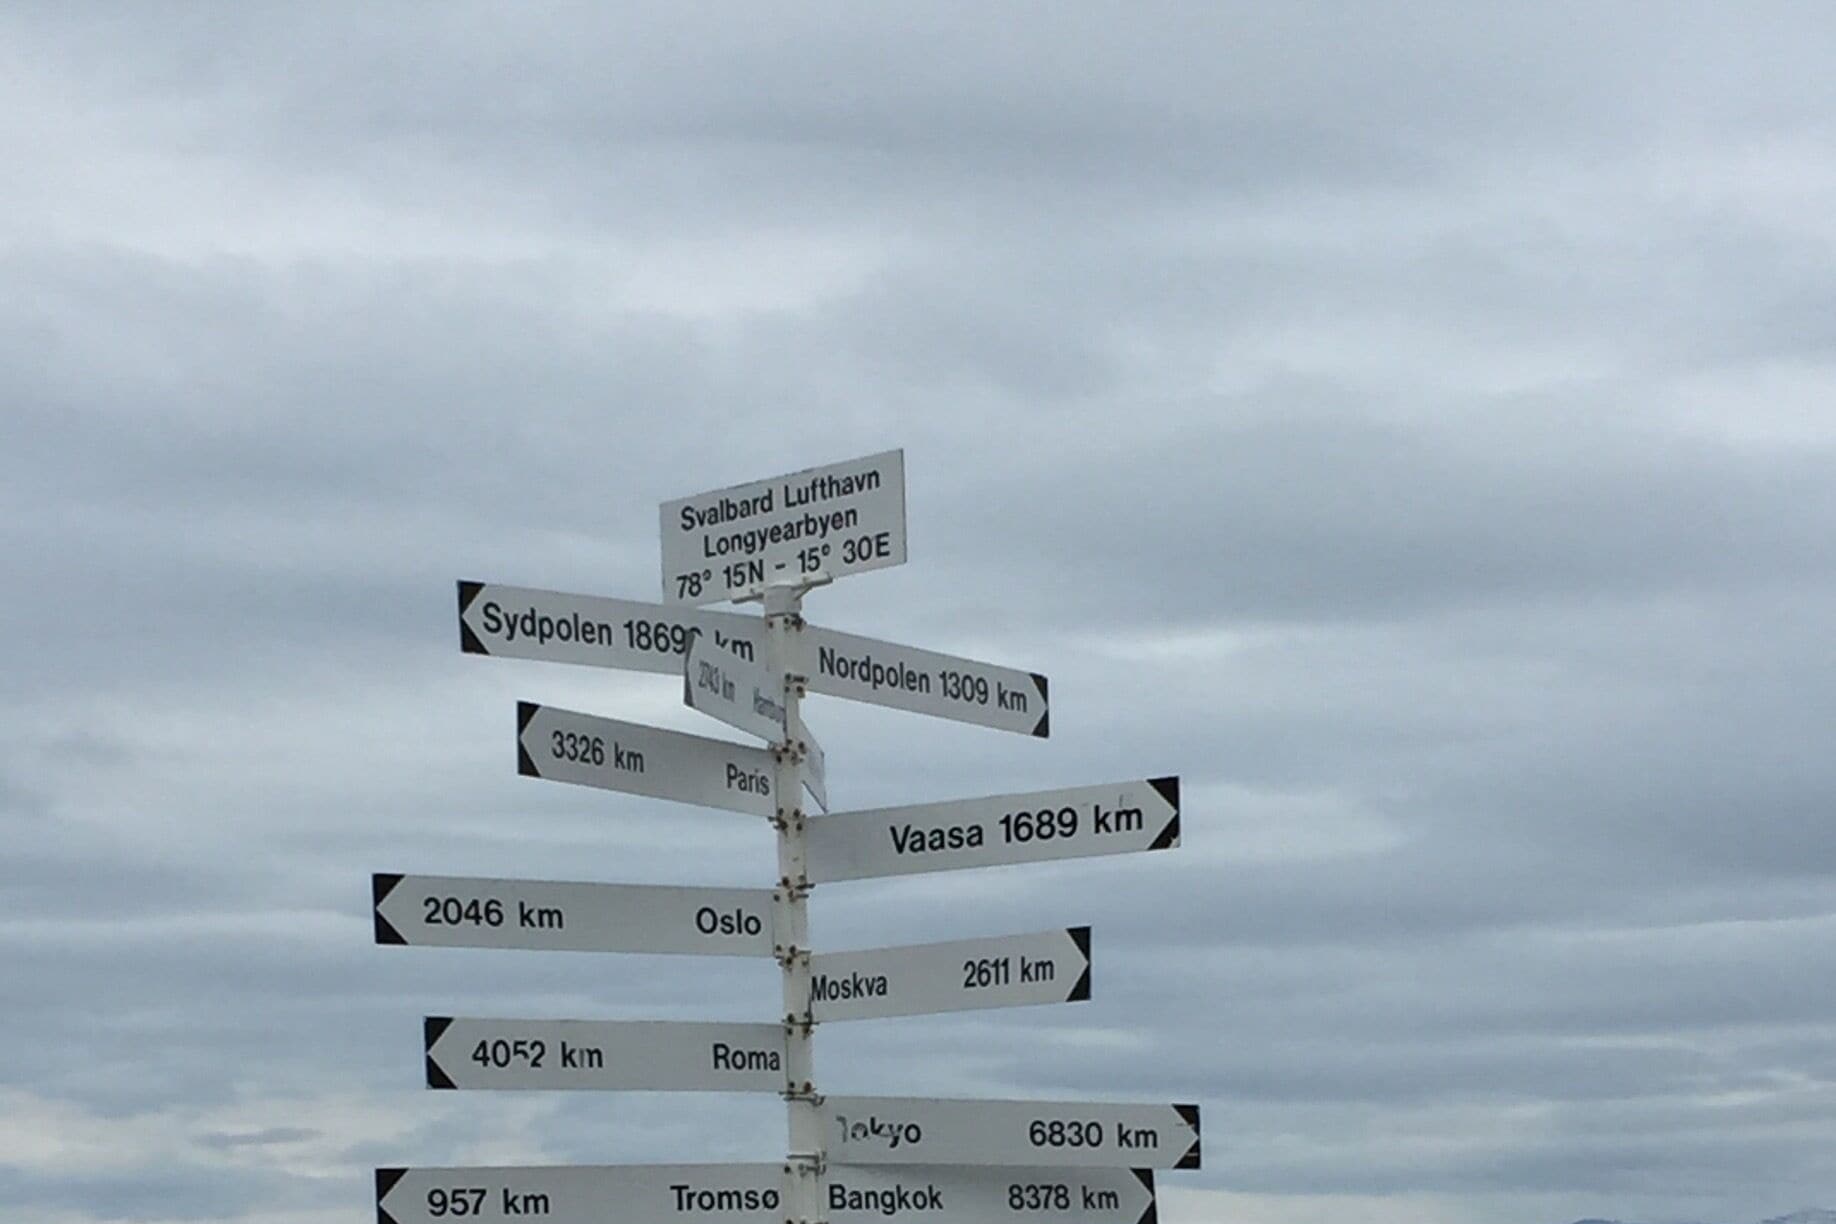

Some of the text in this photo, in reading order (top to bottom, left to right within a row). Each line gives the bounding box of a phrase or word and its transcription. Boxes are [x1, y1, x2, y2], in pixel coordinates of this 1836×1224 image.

[680, 469, 881, 532] Svalbard Lufthavn
[703, 508, 858, 558] Longyearbyen
[722, 558, 764, 589] 15N
[842, 531, 891, 565] 30E
[481, 601, 613, 646] Sydpolen
[818, 646, 1028, 713] Nordpolen 1309 km
[551, 729, 770, 796] 3326 km Paris
[889, 804, 1143, 855] Vaasa 1689 km
[423, 896, 762, 936] 2046 km Oslo
[811, 955, 1055, 1002] Moskva 2611 km
[471, 1039, 781, 1071] 4052 km Roma
[836, 1116, 1158, 1149] Tokyo 6830 km
[427, 1184, 780, 1217] 957 km Tromsø
[828, 1183, 1119, 1216] Bangkok 8378 km
